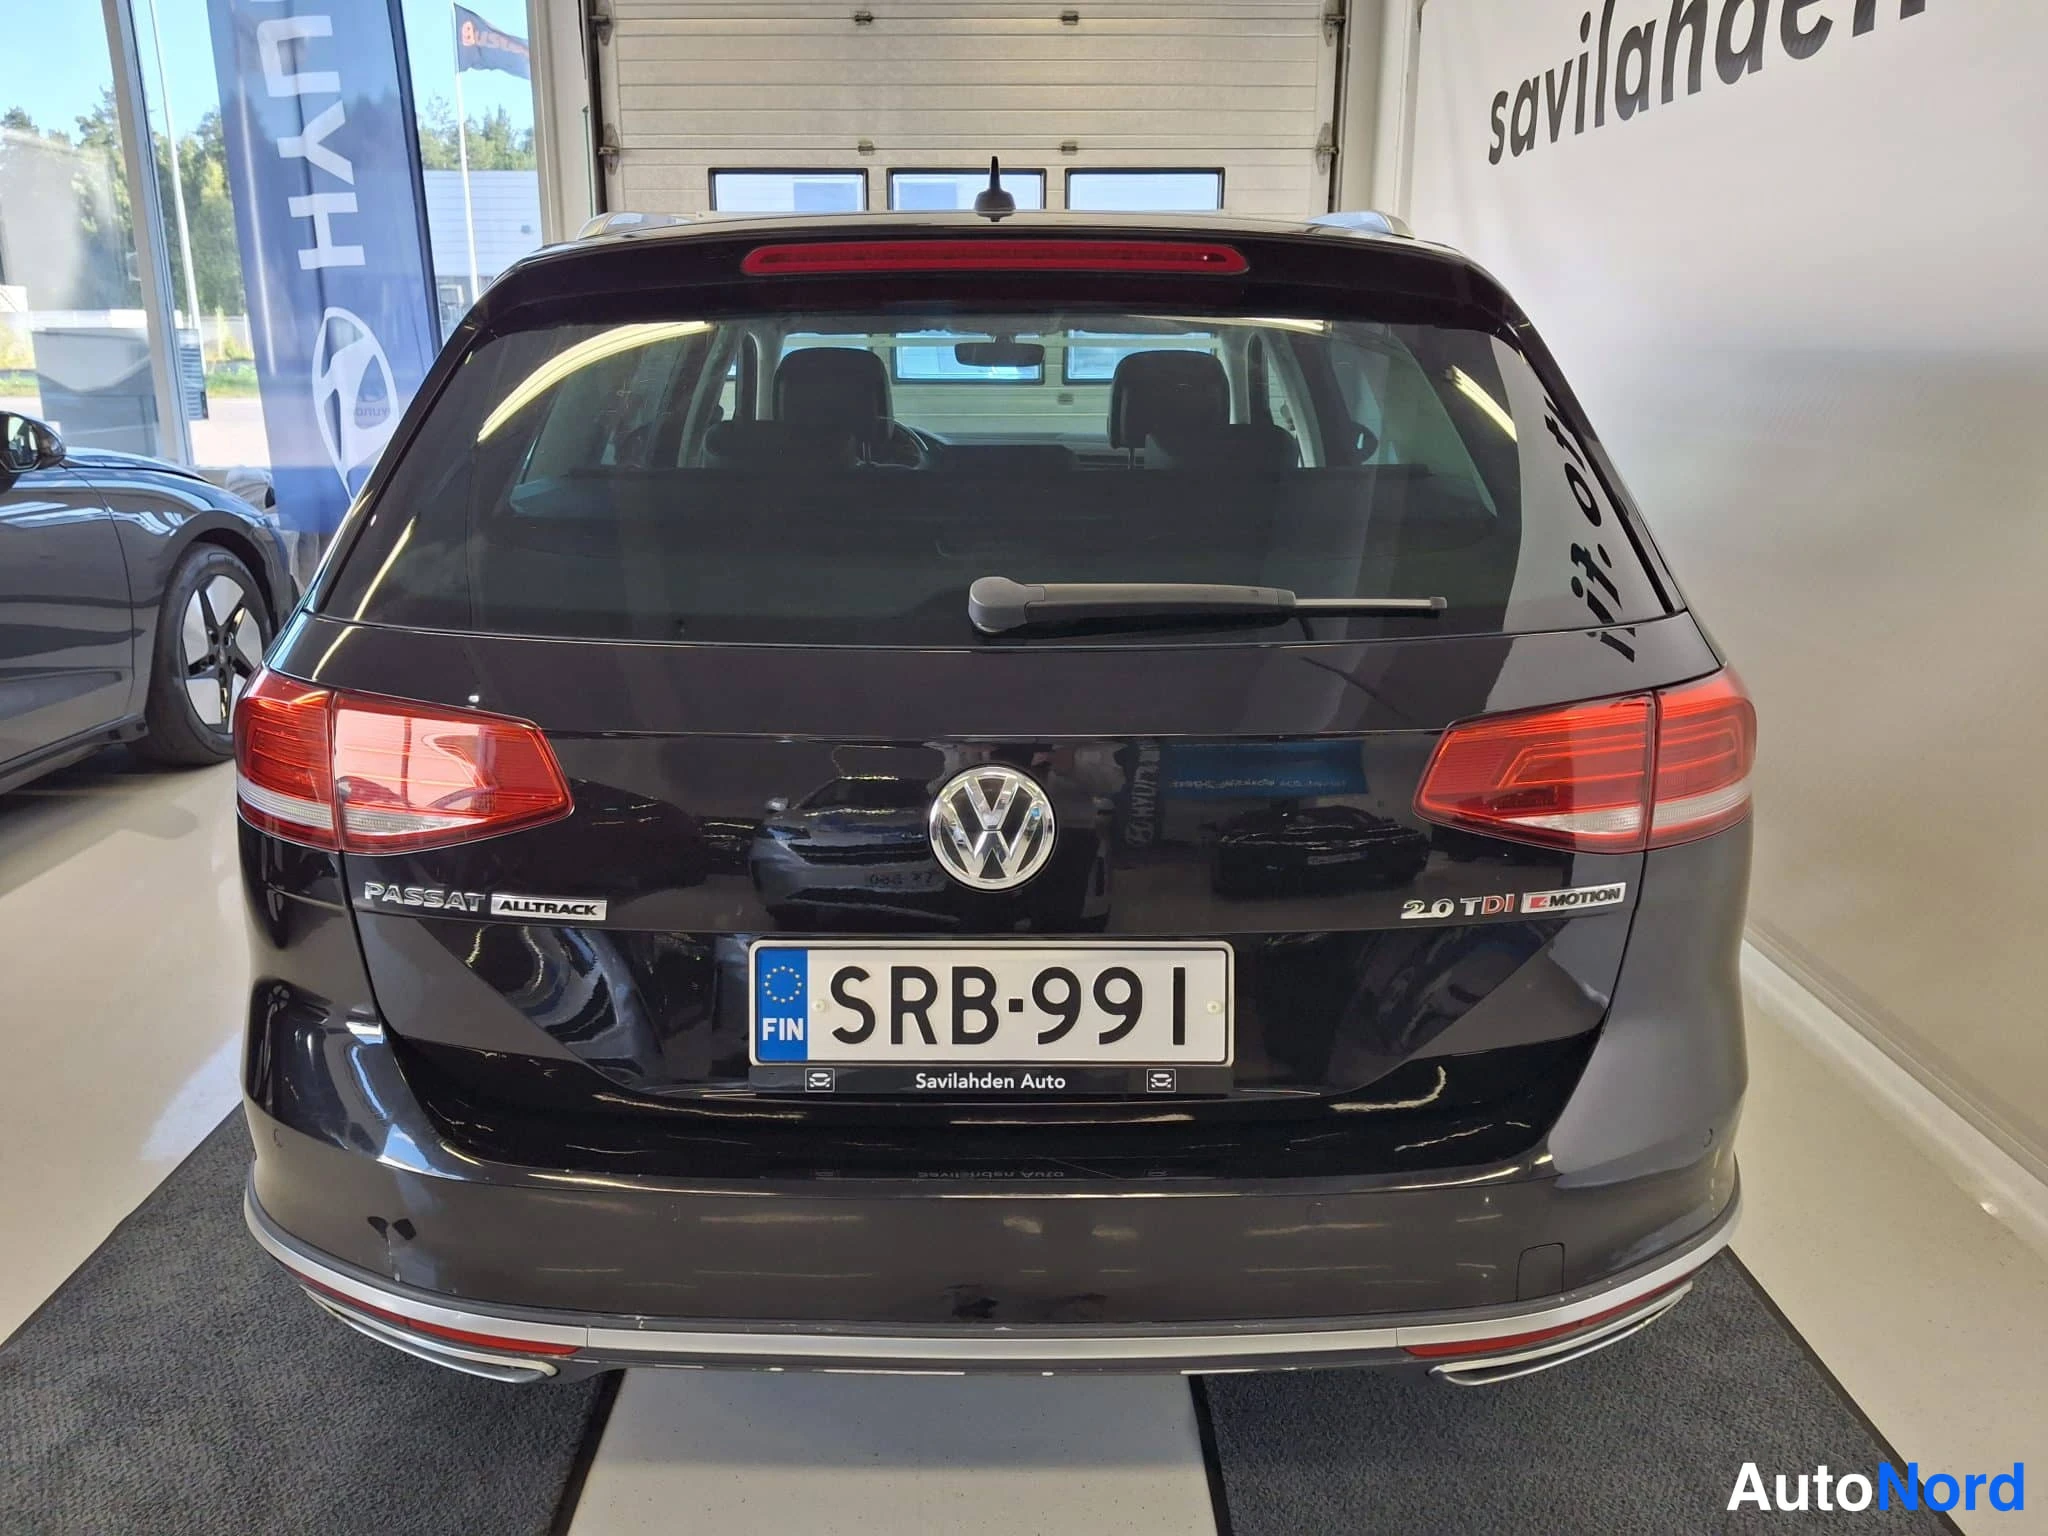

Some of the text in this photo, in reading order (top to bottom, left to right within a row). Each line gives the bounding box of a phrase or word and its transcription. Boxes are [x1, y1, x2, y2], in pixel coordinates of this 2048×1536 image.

[364, 881, 598, 916] PASSAT ALLTRACK
[1400, 898, 1455, 920] 2.0
[1460, 893, 1515, 916] TDI
[830, 965, 1187, 1045] SRB-991
[762, 1017, 804, 1041] FIN
[915, 1071, 1066, 1089] Savilahden Auto
